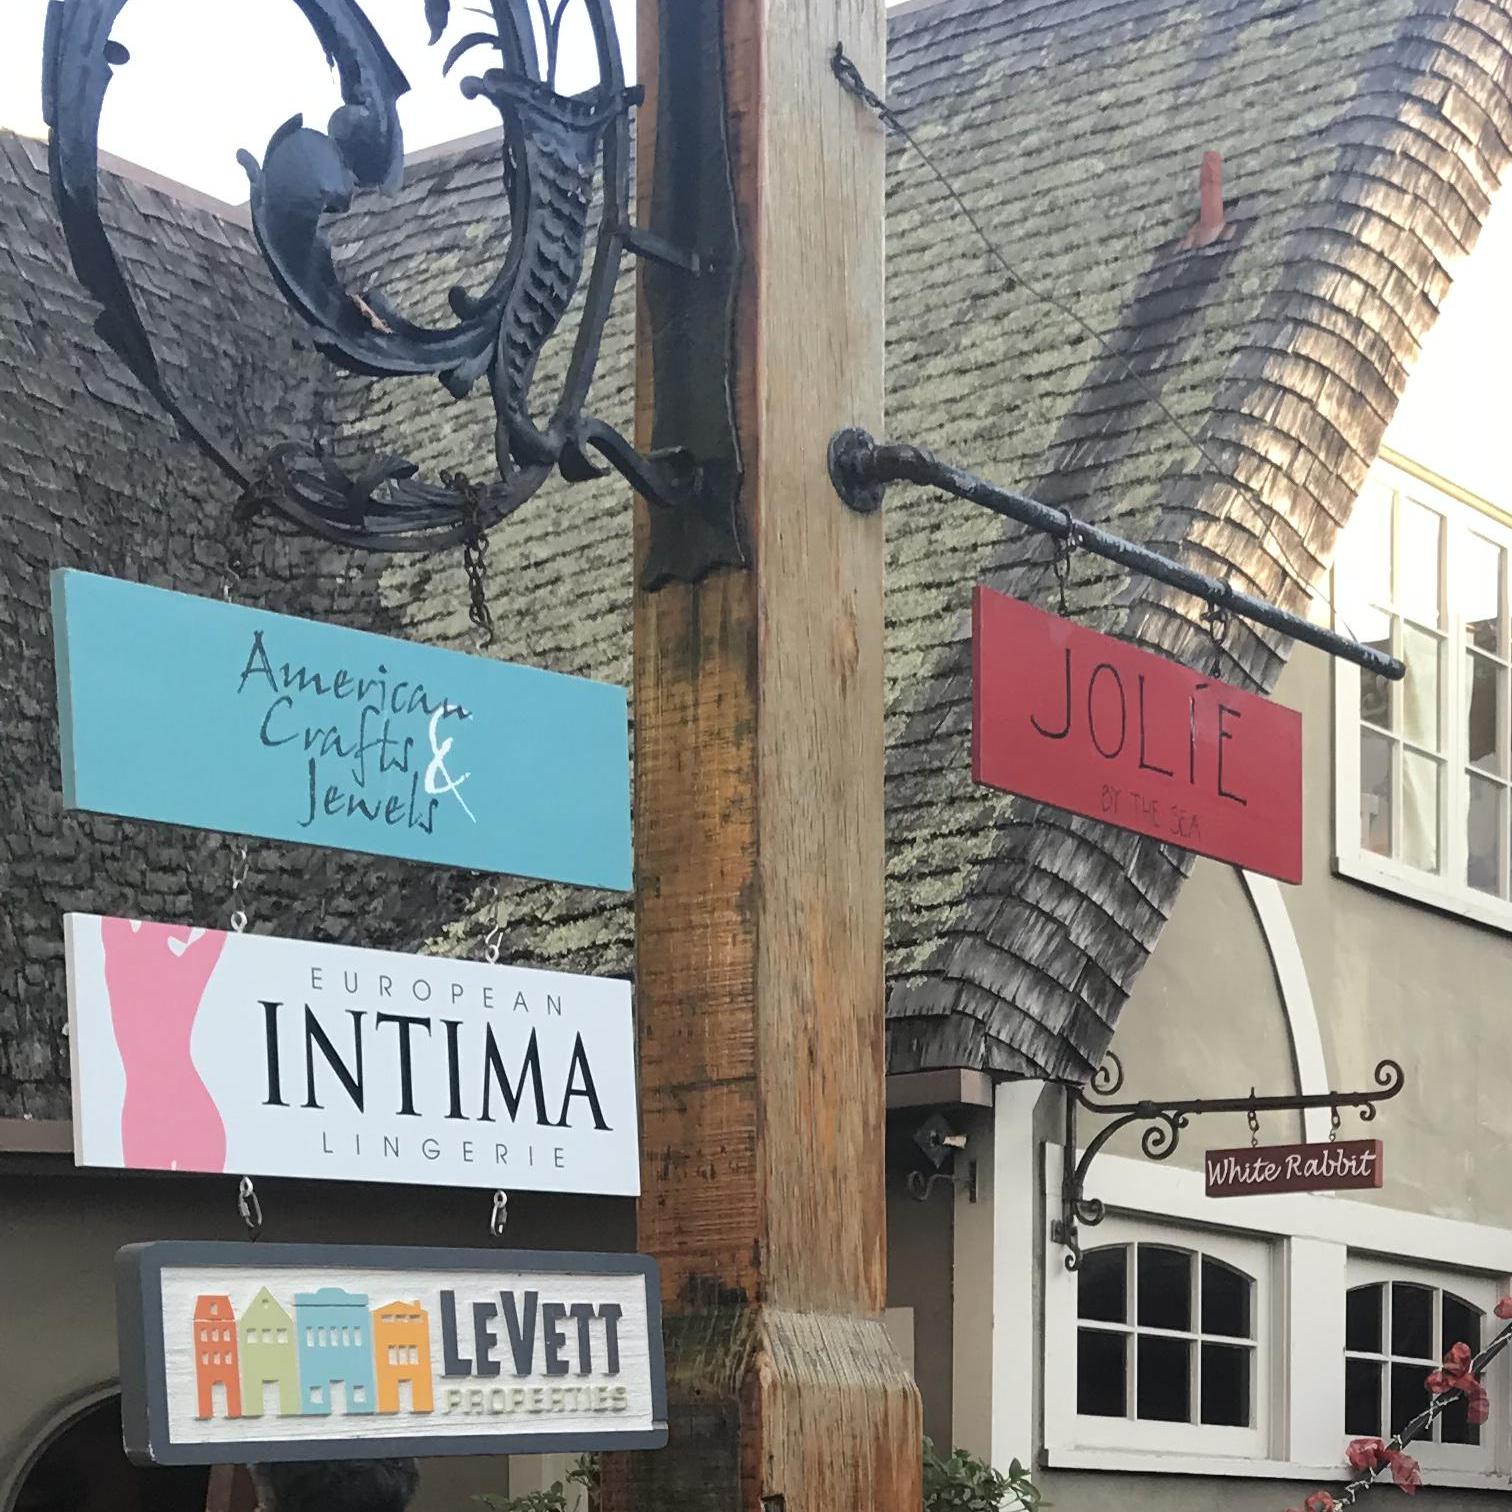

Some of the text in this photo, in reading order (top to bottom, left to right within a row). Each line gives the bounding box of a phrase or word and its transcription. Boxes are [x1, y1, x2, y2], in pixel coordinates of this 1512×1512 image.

[237, 630, 472, 720] American
[260, 697, 476, 823] Crafts &
[299, 760, 440, 834] Jewels
[310, 966, 562, 1017] EUROPEAN
[257, 1000, 613, 1131] INTIMA
[322, 1131, 566, 1169] LINGERIE
[1207, 1148, 1377, 1187] White Rabbit
[443, 1385, 628, 1416] PROPERTIES
